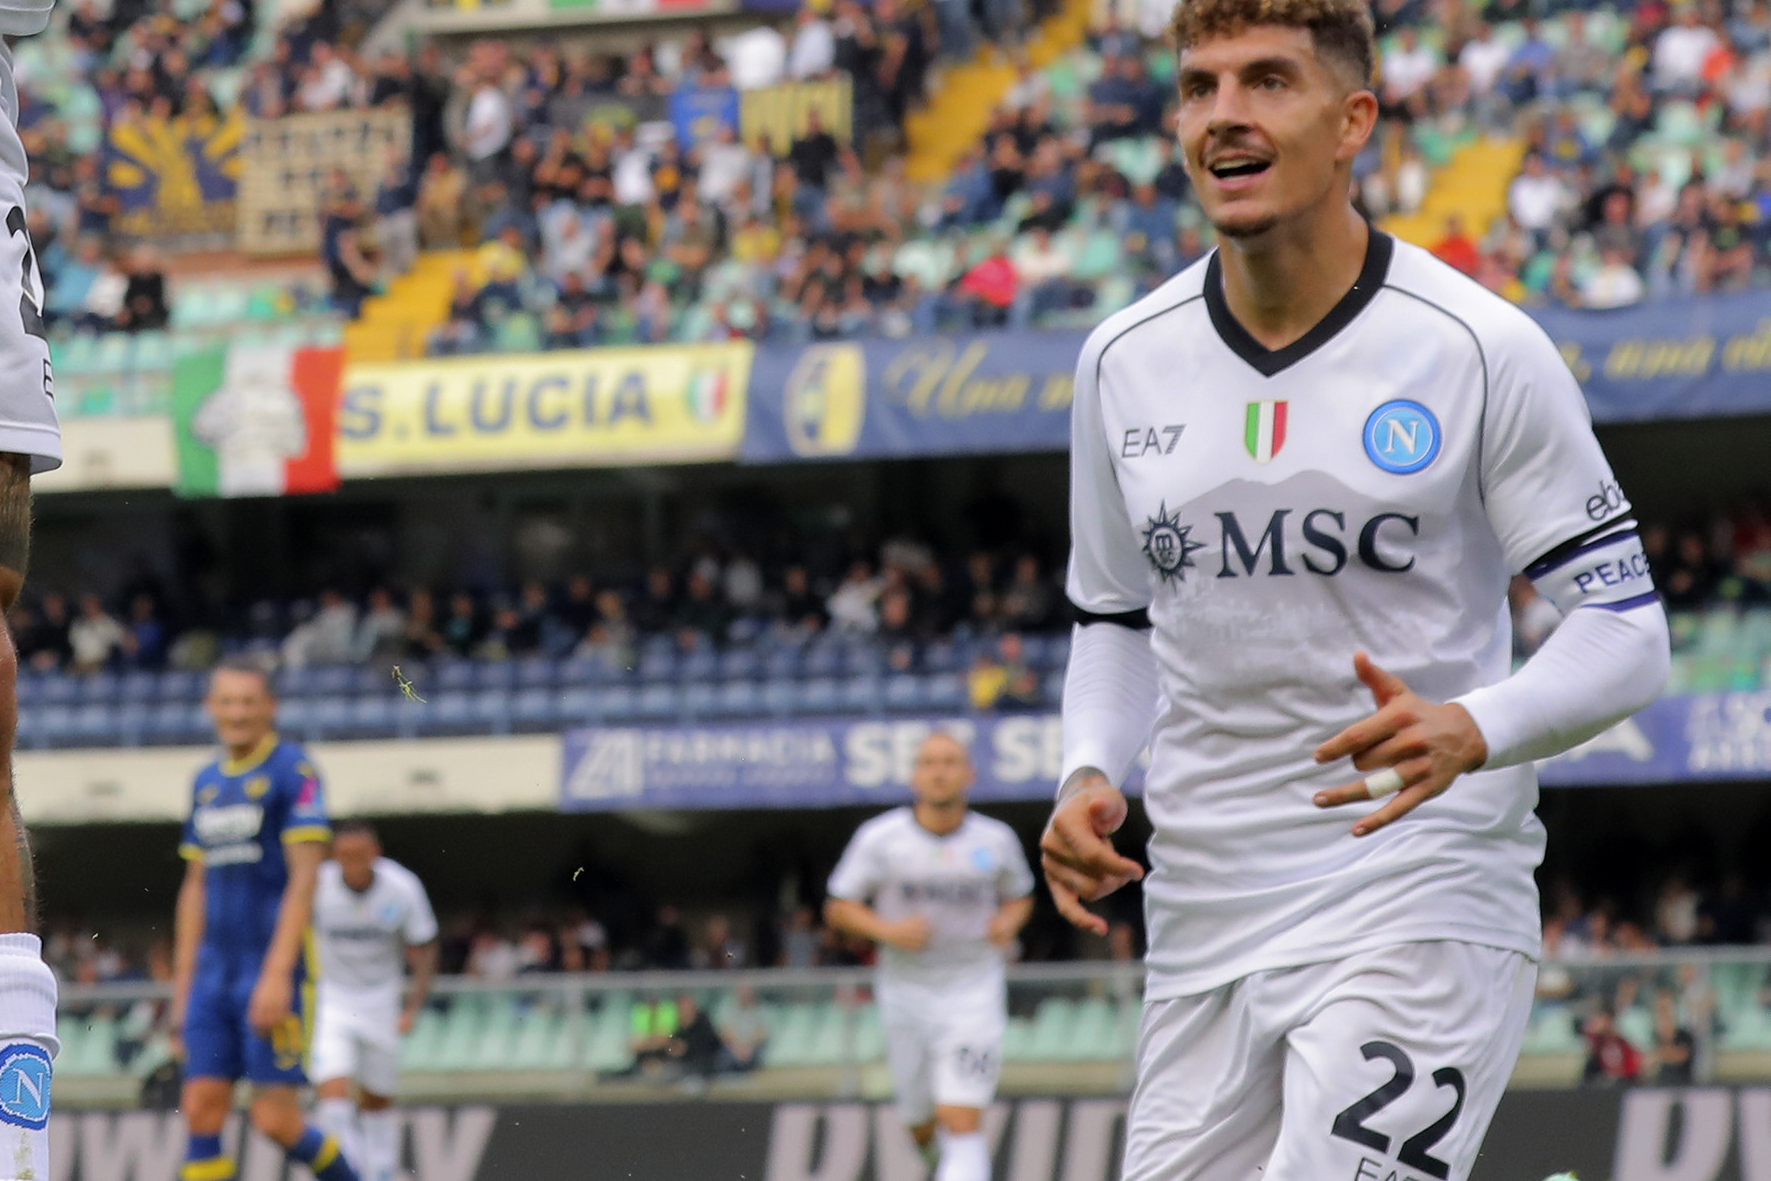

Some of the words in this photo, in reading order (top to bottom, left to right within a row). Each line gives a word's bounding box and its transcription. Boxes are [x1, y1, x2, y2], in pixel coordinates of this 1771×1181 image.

[339, 371, 652, 441] S.LUCIA
[1385, 419, 1418, 455] N
[1122, 424, 1186, 458] EA7
[1214, 509, 1419, 578] MSC
[1330, 1040, 1466, 1181] 22
